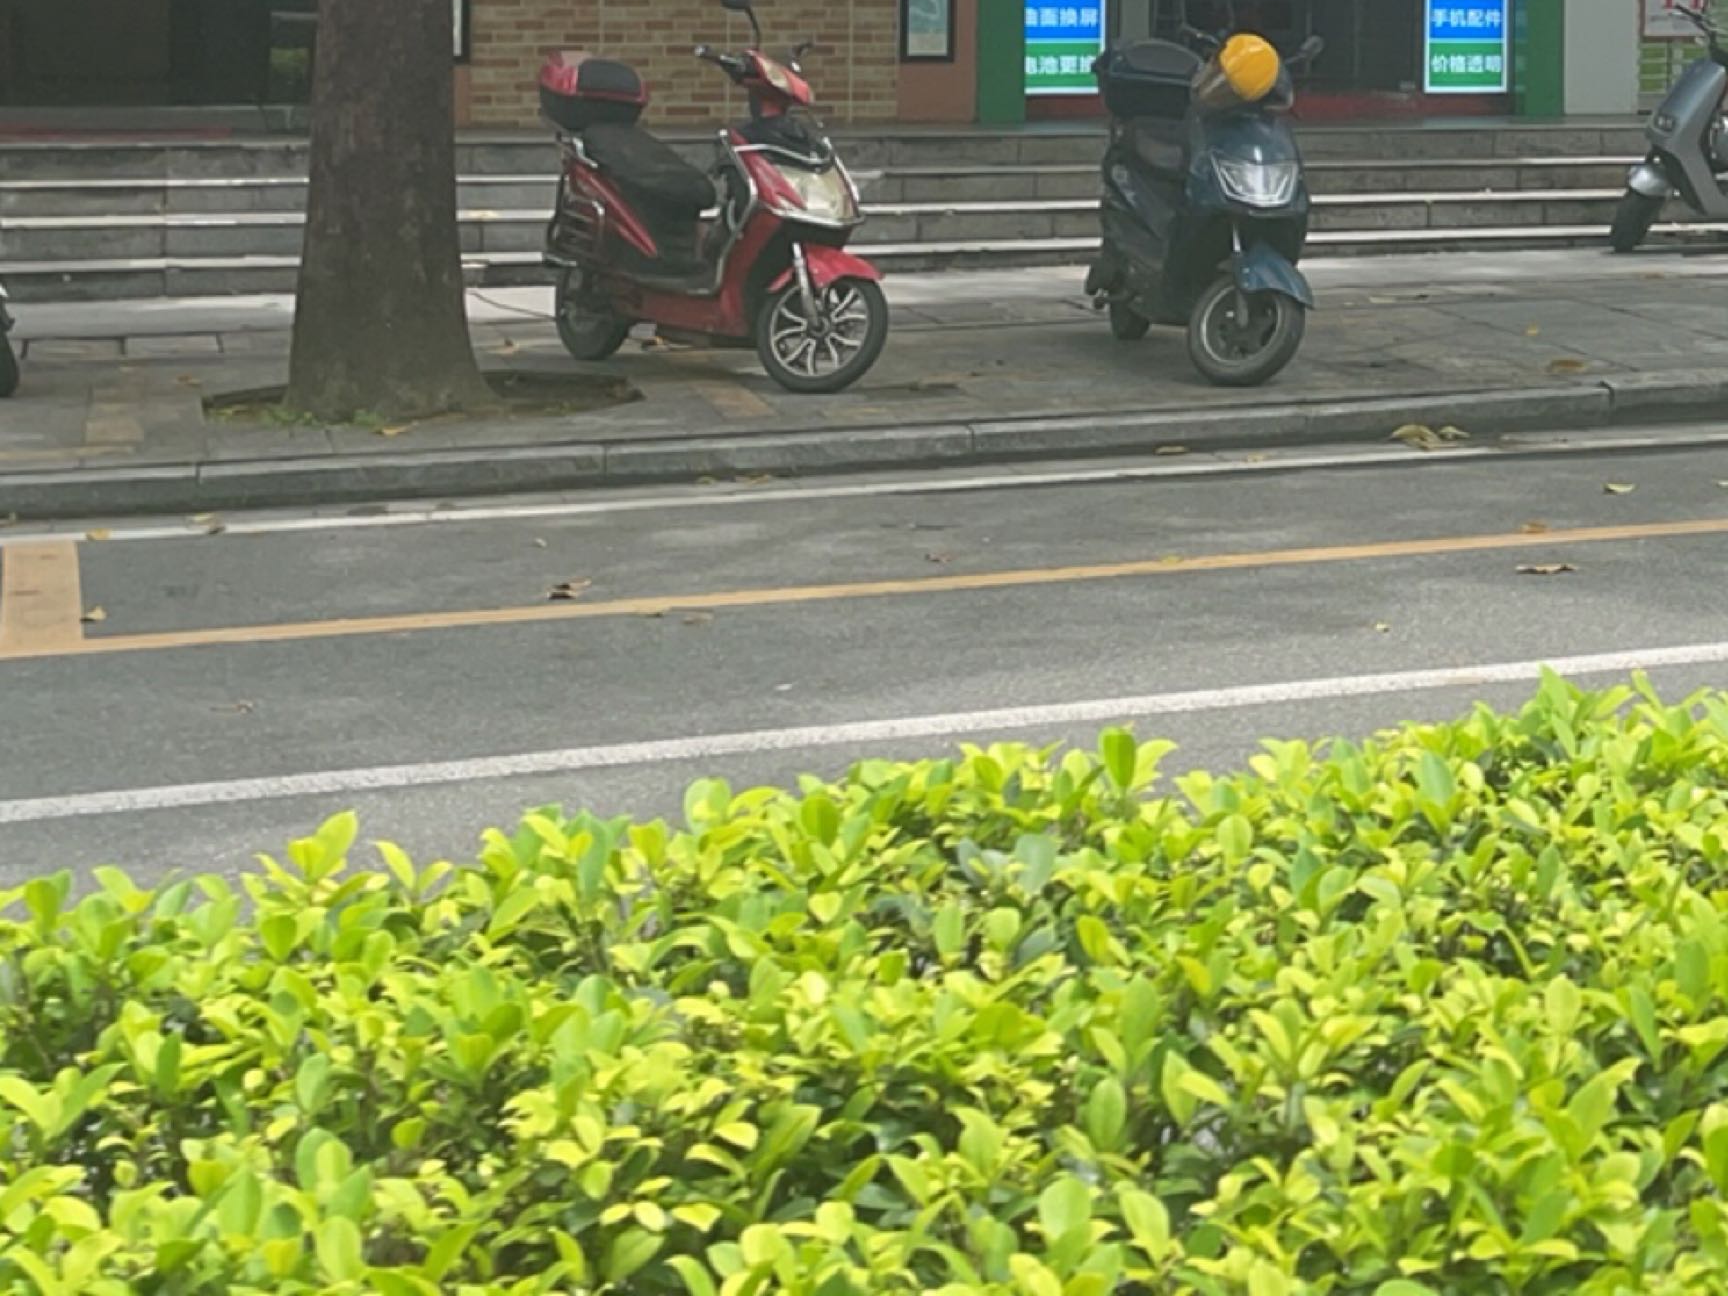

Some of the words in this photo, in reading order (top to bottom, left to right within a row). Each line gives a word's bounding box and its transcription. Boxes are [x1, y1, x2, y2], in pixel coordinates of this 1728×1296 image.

[1431, 9, 1502, 28] 手机配件
[1430, 54, 1502, 74] 价格透明
